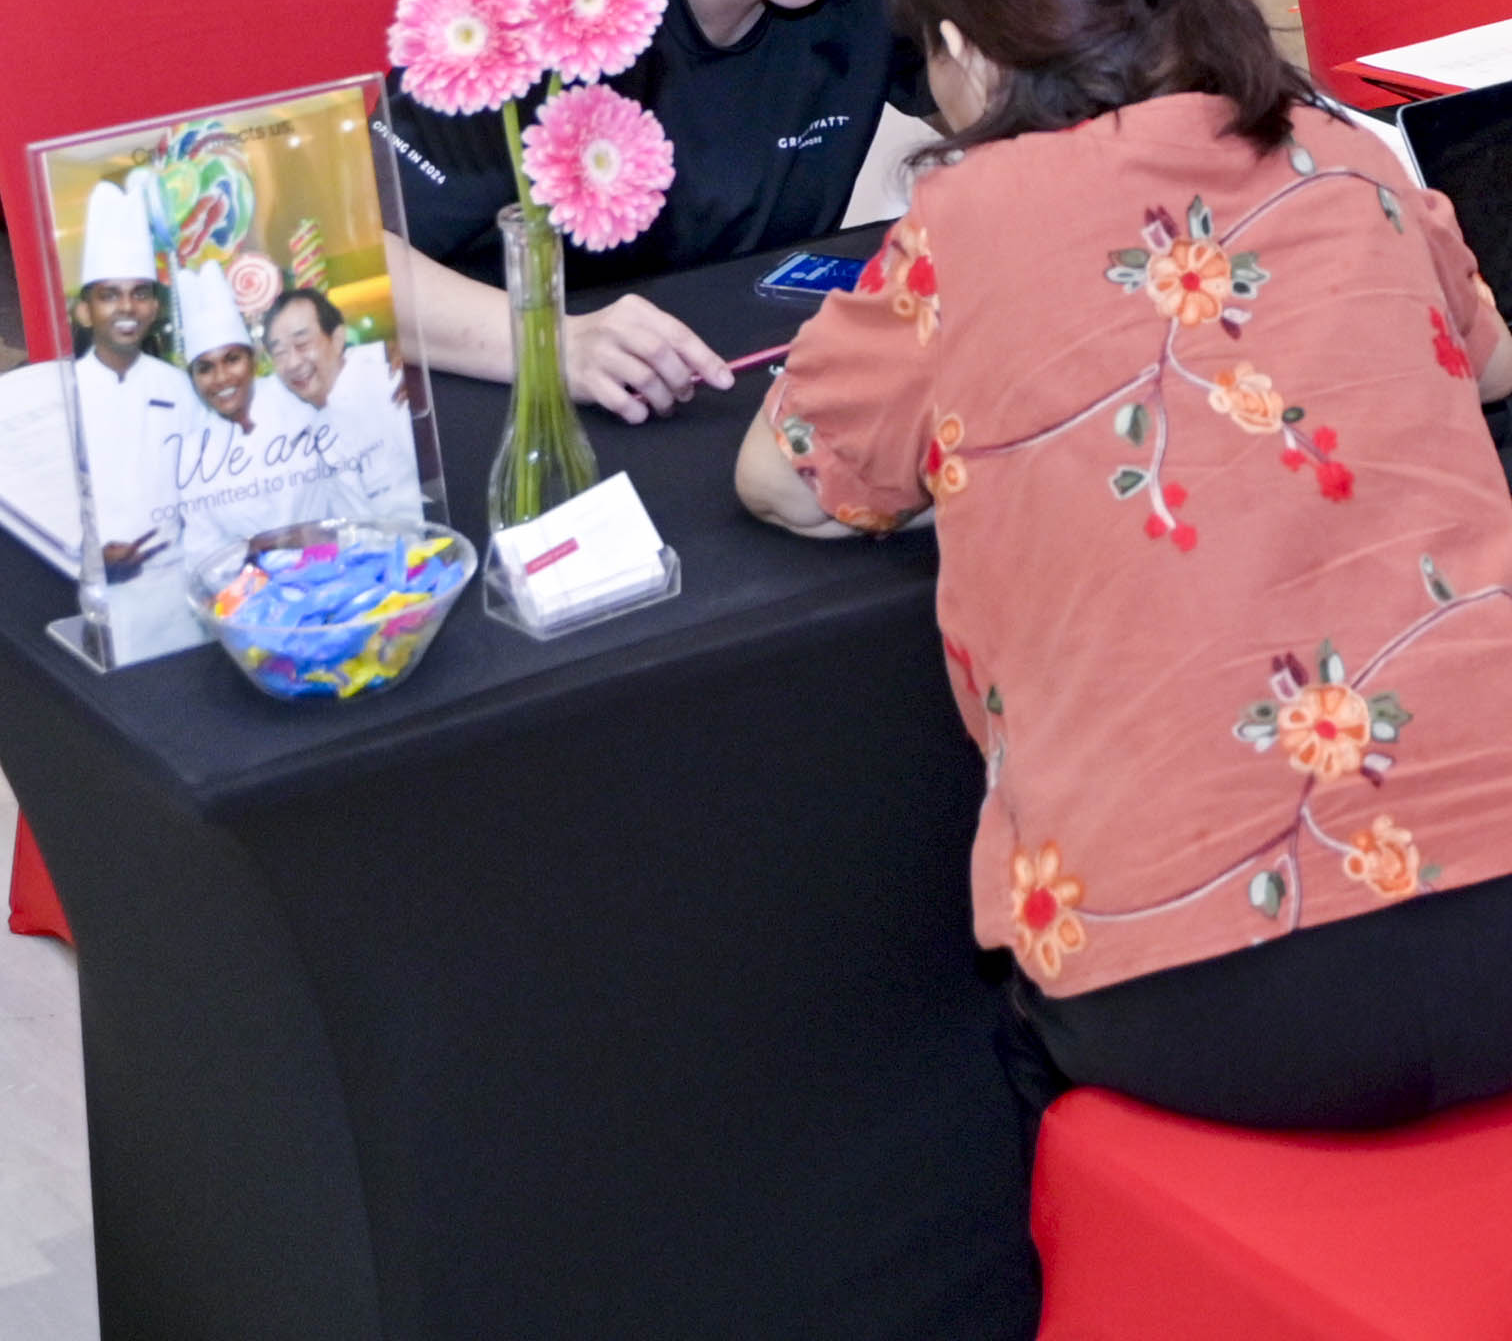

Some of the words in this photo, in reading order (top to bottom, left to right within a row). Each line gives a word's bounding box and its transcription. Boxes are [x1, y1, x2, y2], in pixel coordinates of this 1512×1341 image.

[164, 431, 253, 491] We
[263, 422, 340, 469] are
[150, 479, 261, 523] committed
[263, 475, 285, 499] to
